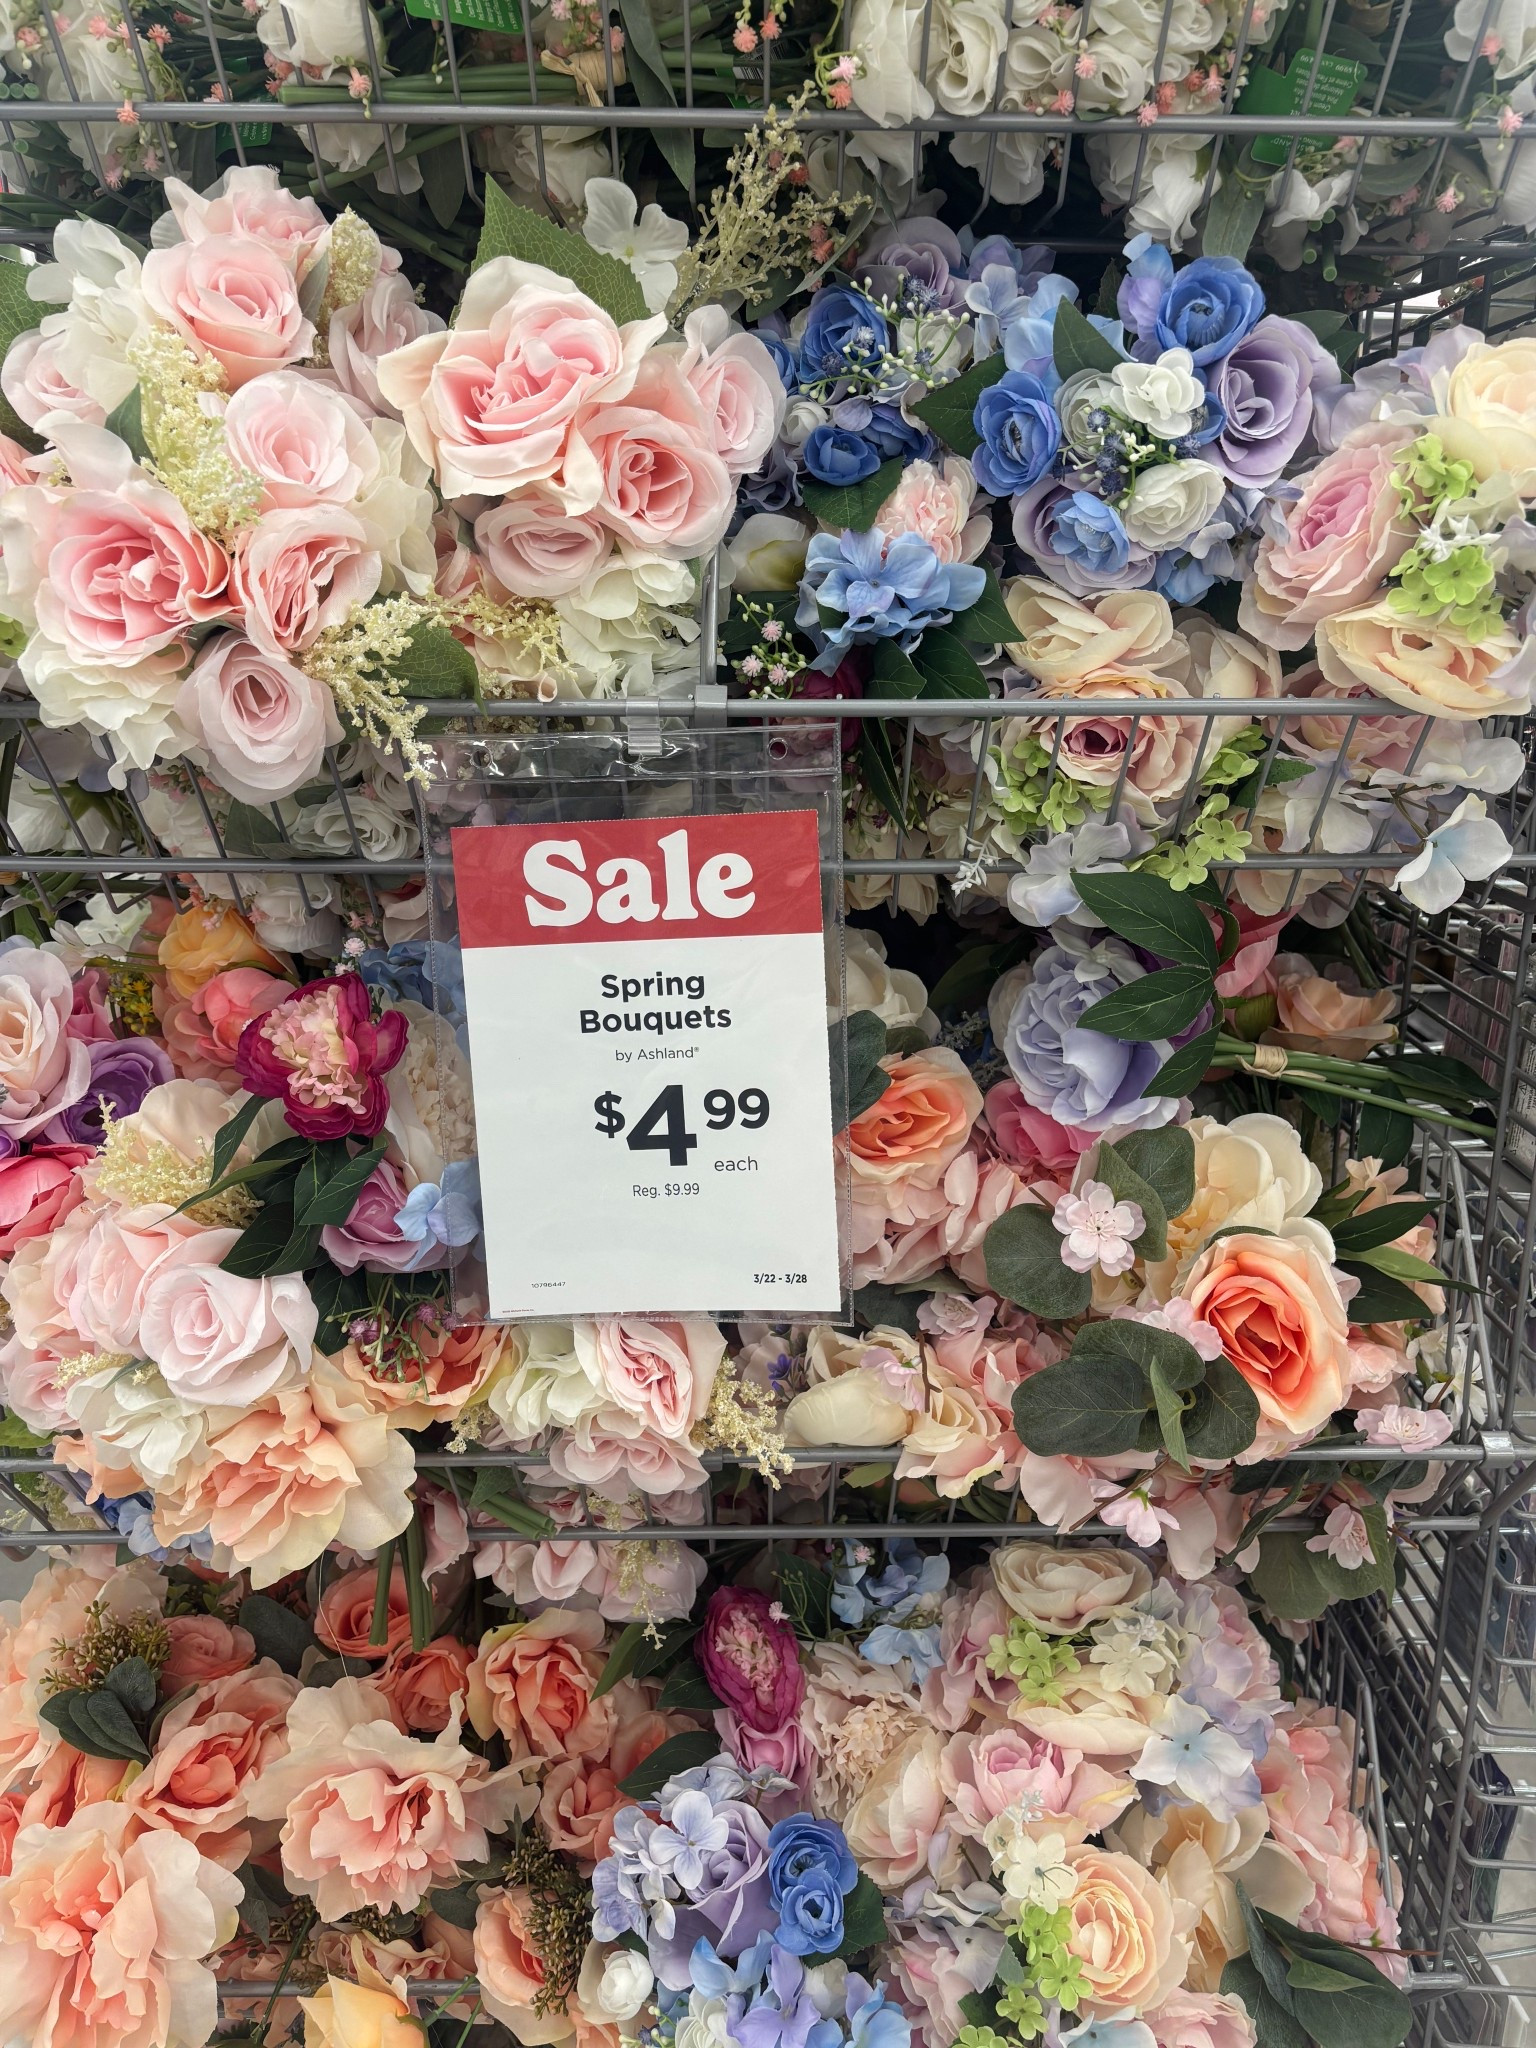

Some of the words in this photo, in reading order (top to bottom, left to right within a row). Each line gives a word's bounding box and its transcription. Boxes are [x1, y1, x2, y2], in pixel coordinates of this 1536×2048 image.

[523, 829, 756, 927] Sale
[601, 972, 705, 1003] Spring
[580, 1005, 732, 1036] Bouquets
[615, 1049, 632, 1063] by
[714, 1156, 758, 1172] each
[633, 1185, 661, 1199] Reg.
[664, 1183, 700, 1197] $9.99
[754, 1273, 776, 1285] 3/22
[784, 1273, 808, 1285] 3/28
